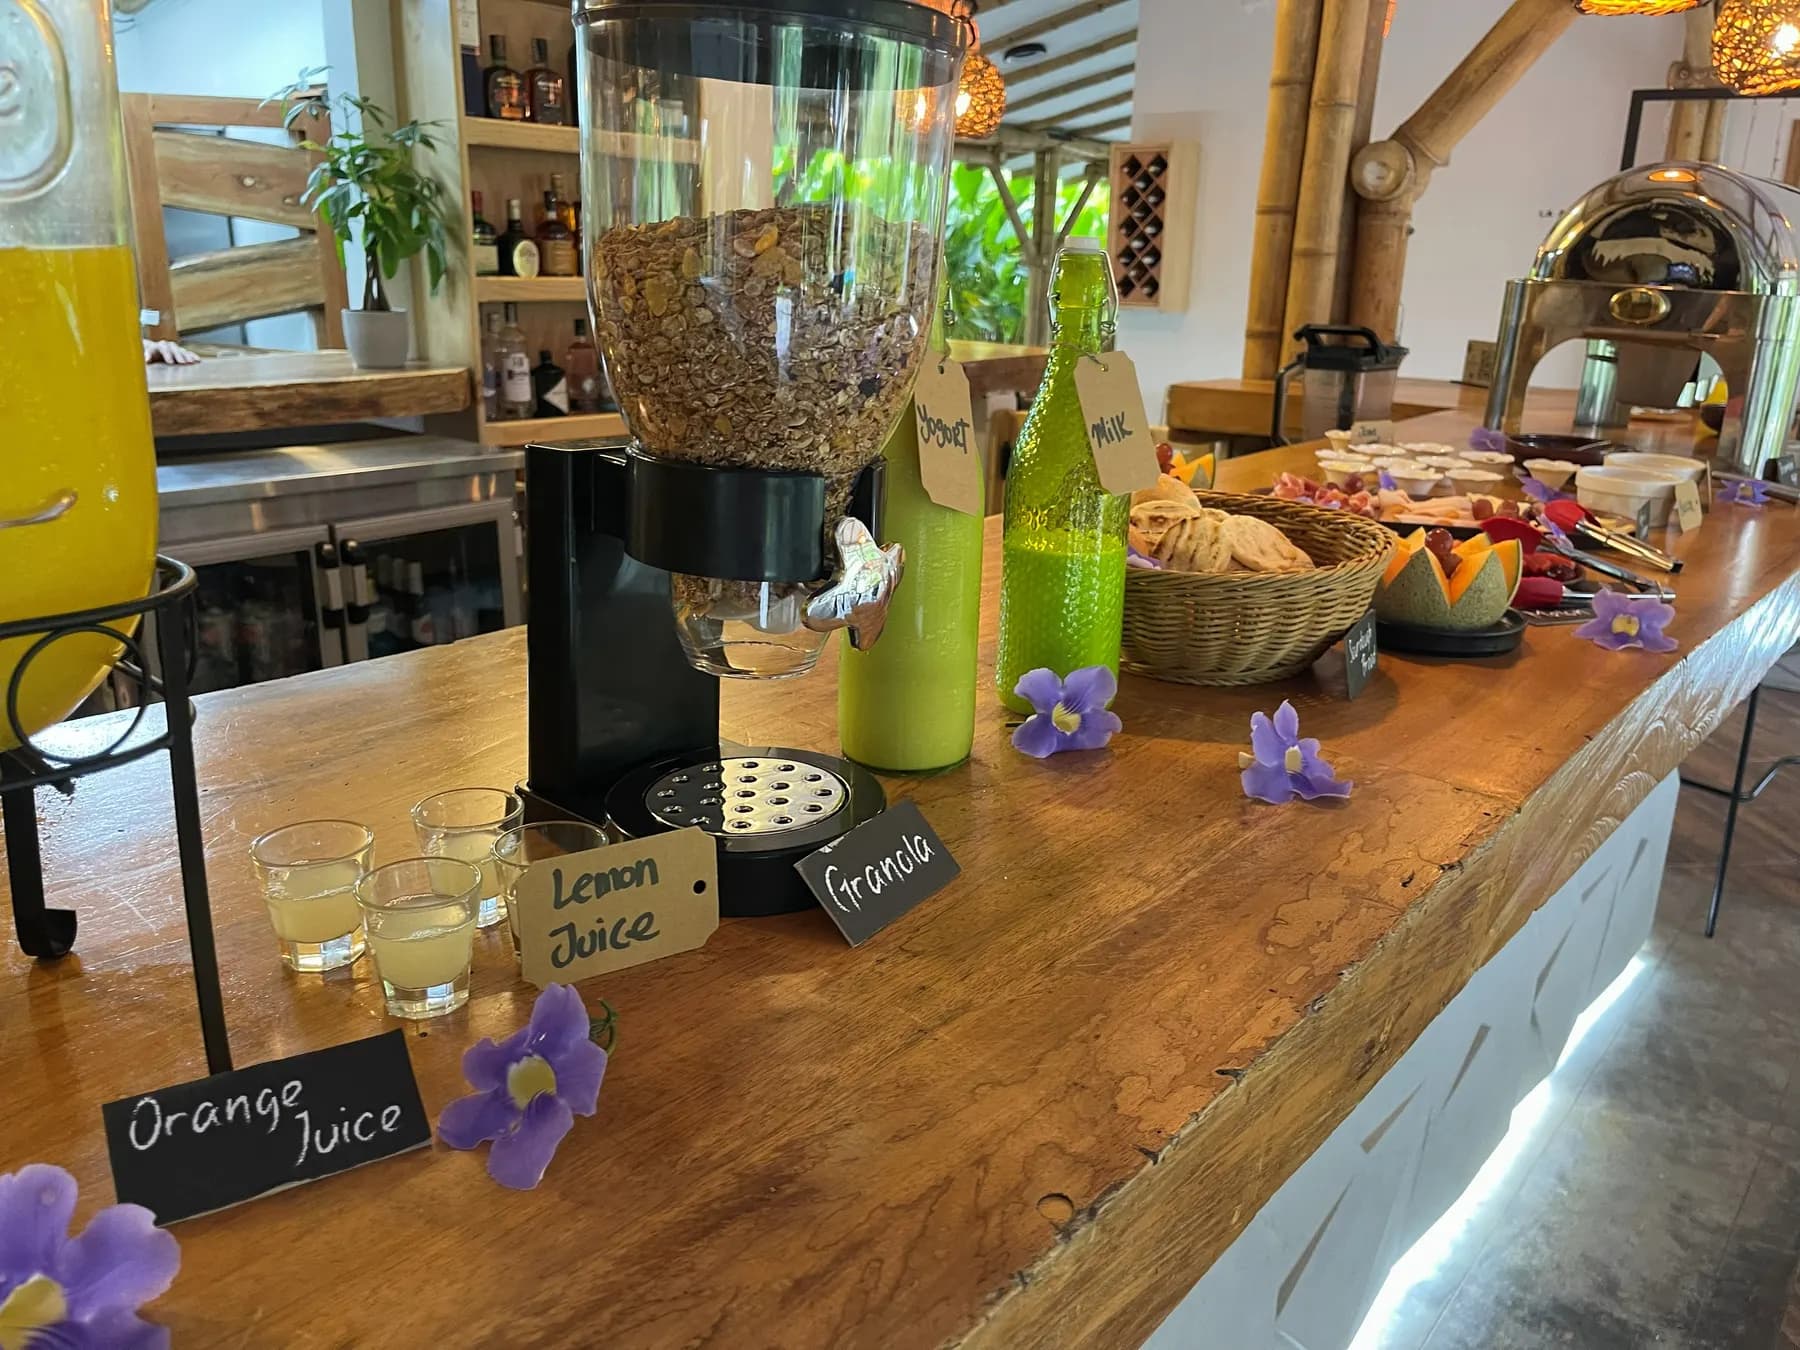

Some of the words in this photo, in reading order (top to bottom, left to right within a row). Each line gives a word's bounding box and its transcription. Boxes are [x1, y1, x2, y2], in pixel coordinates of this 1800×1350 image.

[552, 858, 659, 910] Lemon
[825, 835, 935, 912] Granola
[549, 911, 660, 968] Juice
[129, 1080, 303, 1150] Orange
[295, 1106, 402, 1167] Juice
